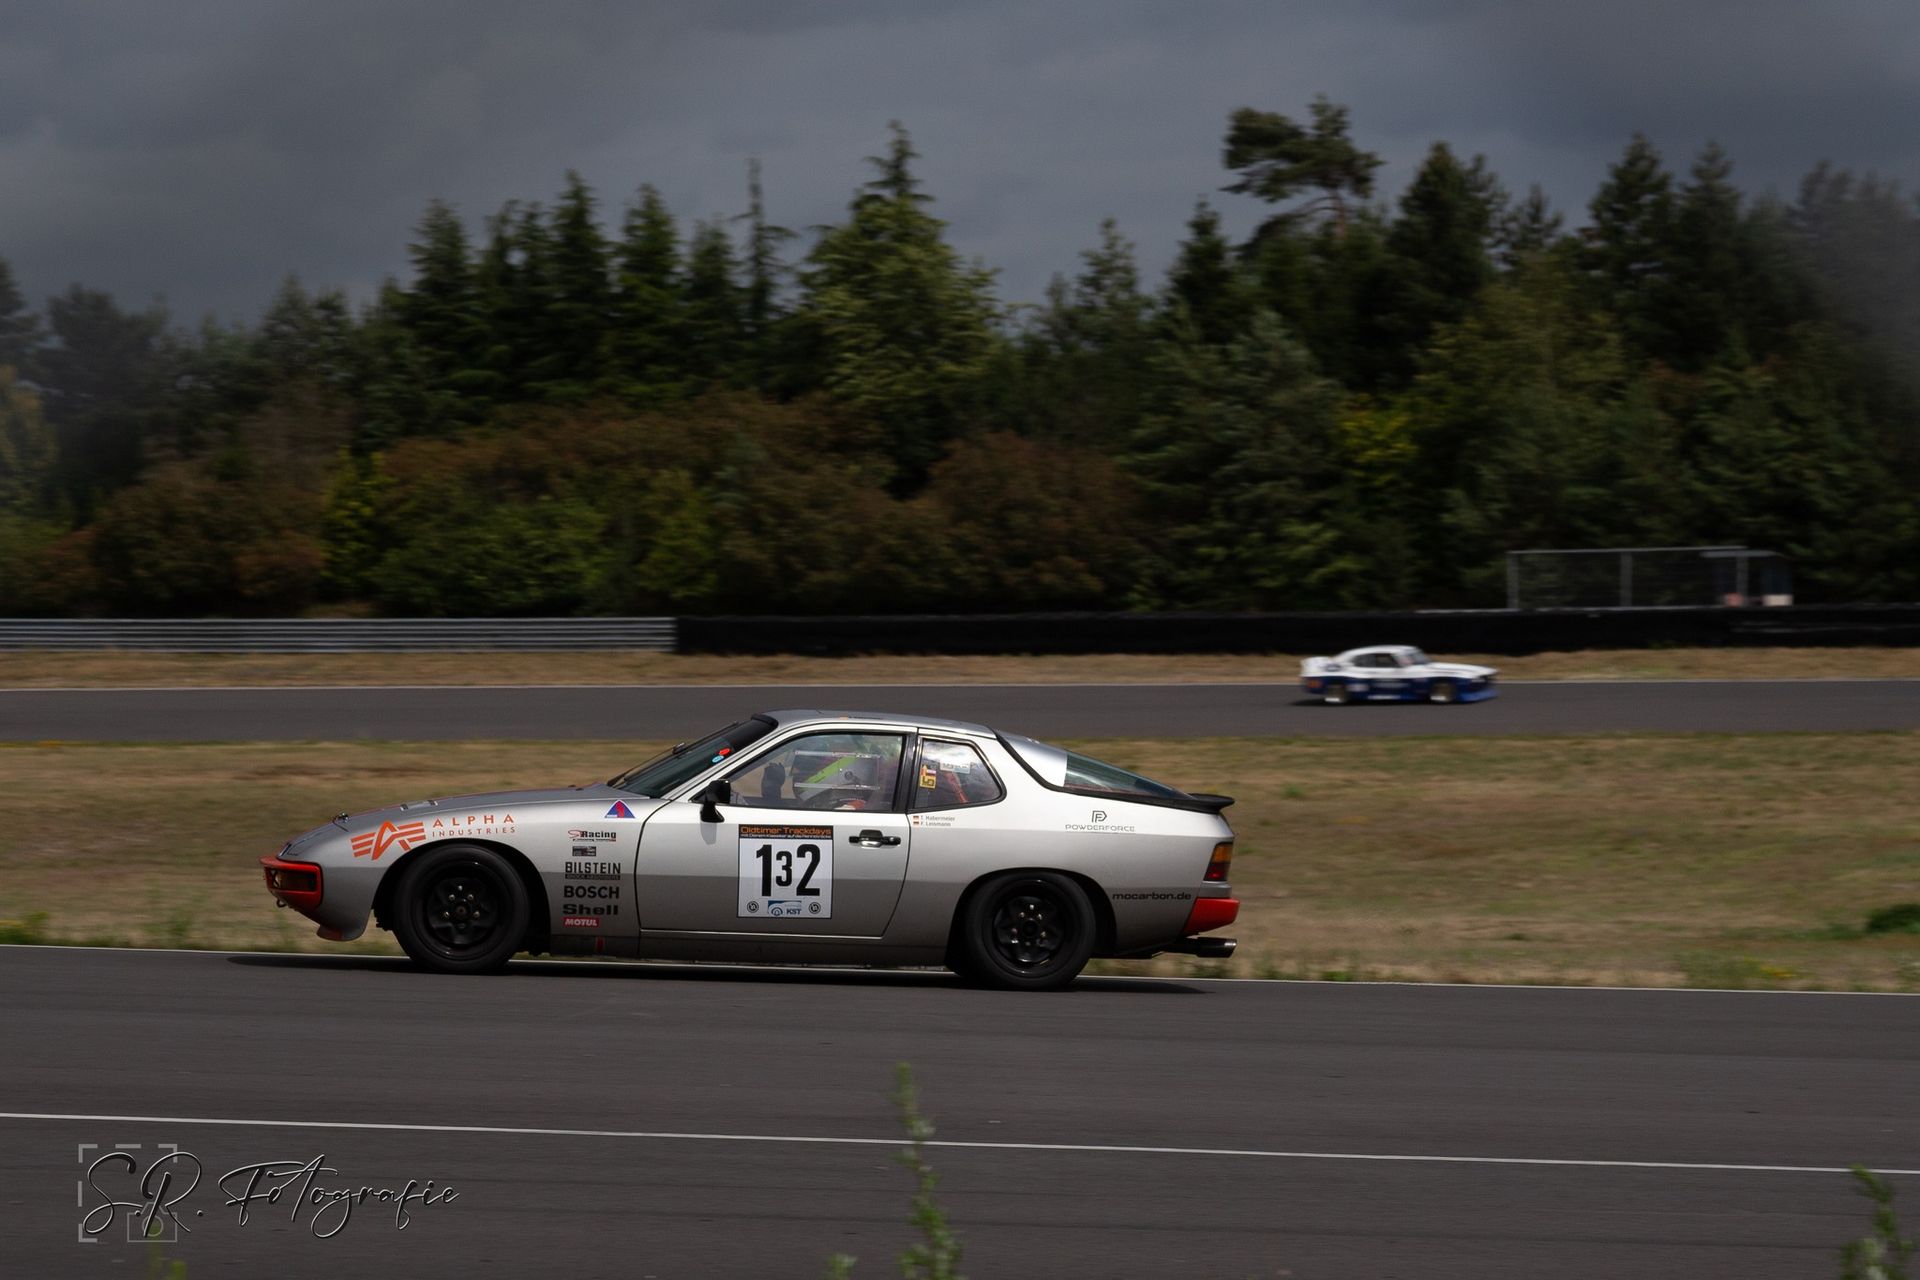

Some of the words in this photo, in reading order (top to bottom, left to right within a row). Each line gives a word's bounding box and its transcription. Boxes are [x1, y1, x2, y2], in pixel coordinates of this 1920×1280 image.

[433, 814, 514, 828] ALPHA
[432, 826, 515, 838] INDUSTRIES
[741, 826, 781, 834] Oldtimer
[783, 826, 831, 835] Trackdays
[1065, 824, 1135, 832] POWDERFORCE
[565, 861, 621, 875] BILSTEIN
[756, 843, 820, 897] 132
[563, 885, 620, 900] BOSCH
[1112, 892, 1191, 901] mocarbon.de
[563, 903, 619, 916] Shell
[565, 918, 598, 927] MOTUL
